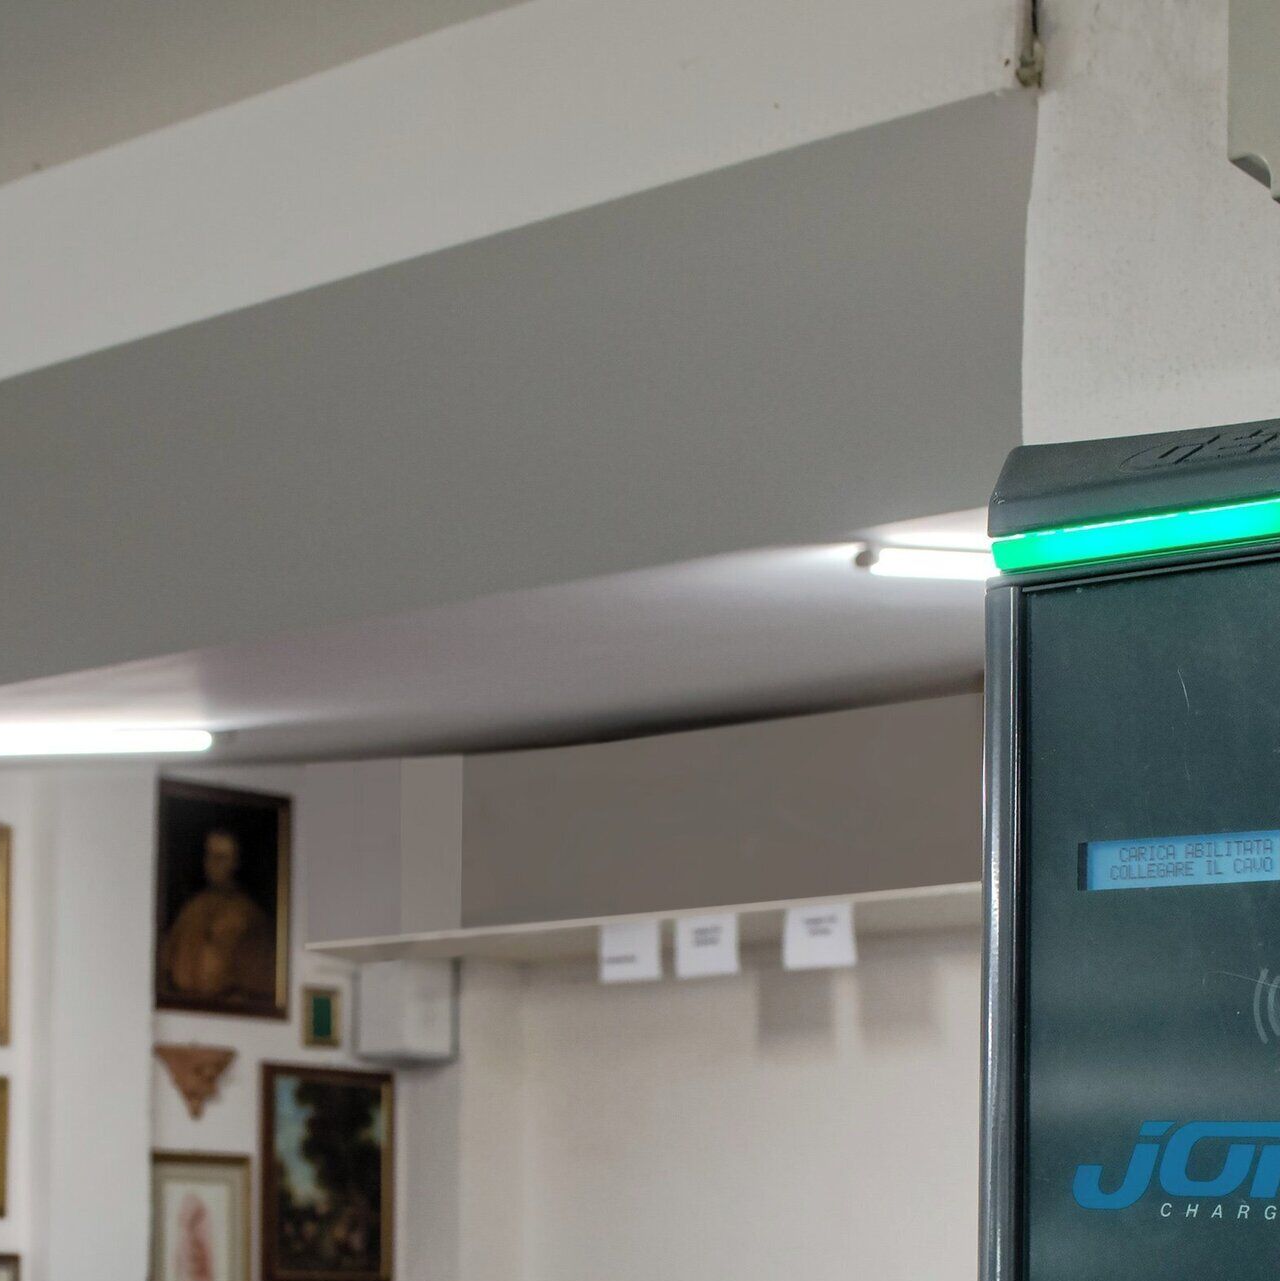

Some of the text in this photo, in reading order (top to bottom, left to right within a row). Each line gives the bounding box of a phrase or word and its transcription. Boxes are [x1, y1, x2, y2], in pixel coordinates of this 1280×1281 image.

[1118, 839, 1273, 863] CARICA ABILITATA
[1110, 857, 1273, 881] COLLEGARE IL CAVO
